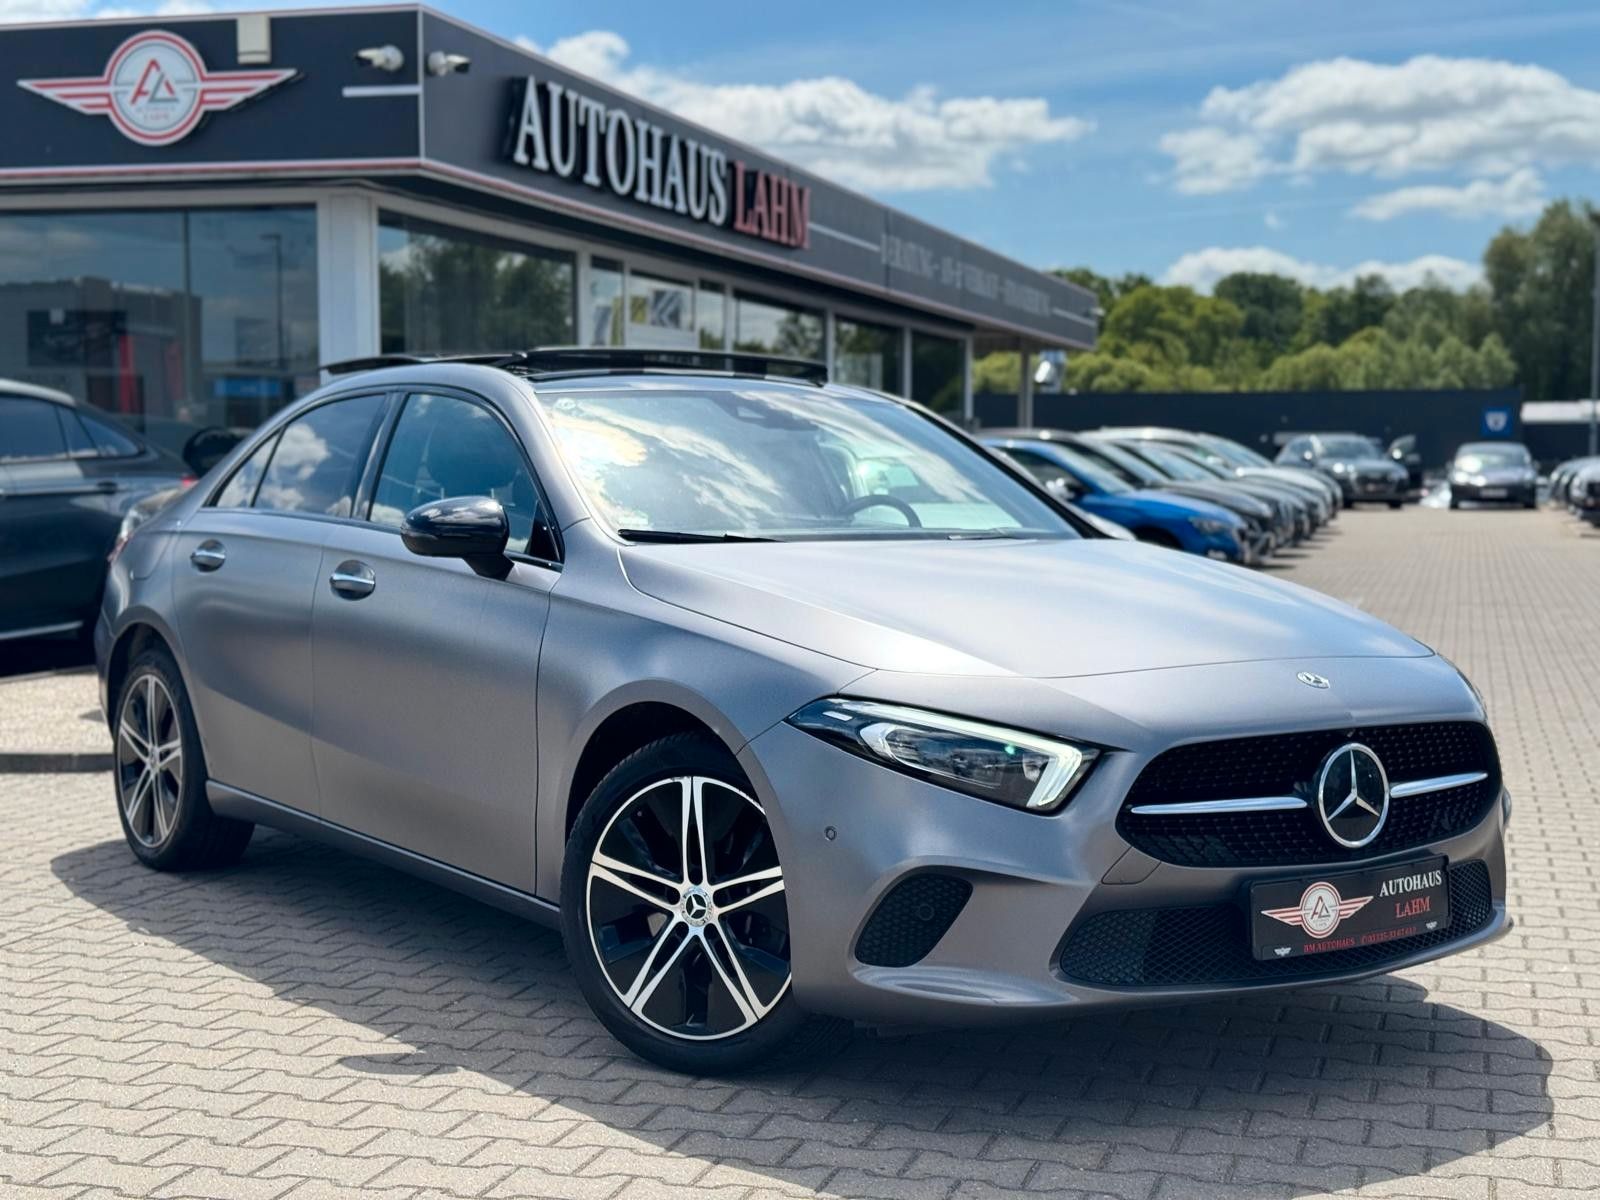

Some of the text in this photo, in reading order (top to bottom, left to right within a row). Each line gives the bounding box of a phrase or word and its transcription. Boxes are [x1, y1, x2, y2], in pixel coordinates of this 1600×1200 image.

[513, 74, 810, 249] AUTOHAUS LAHM
[1379, 870, 1442, 897] AUTOHAUS
[1395, 896, 1430, 918] LAHM
